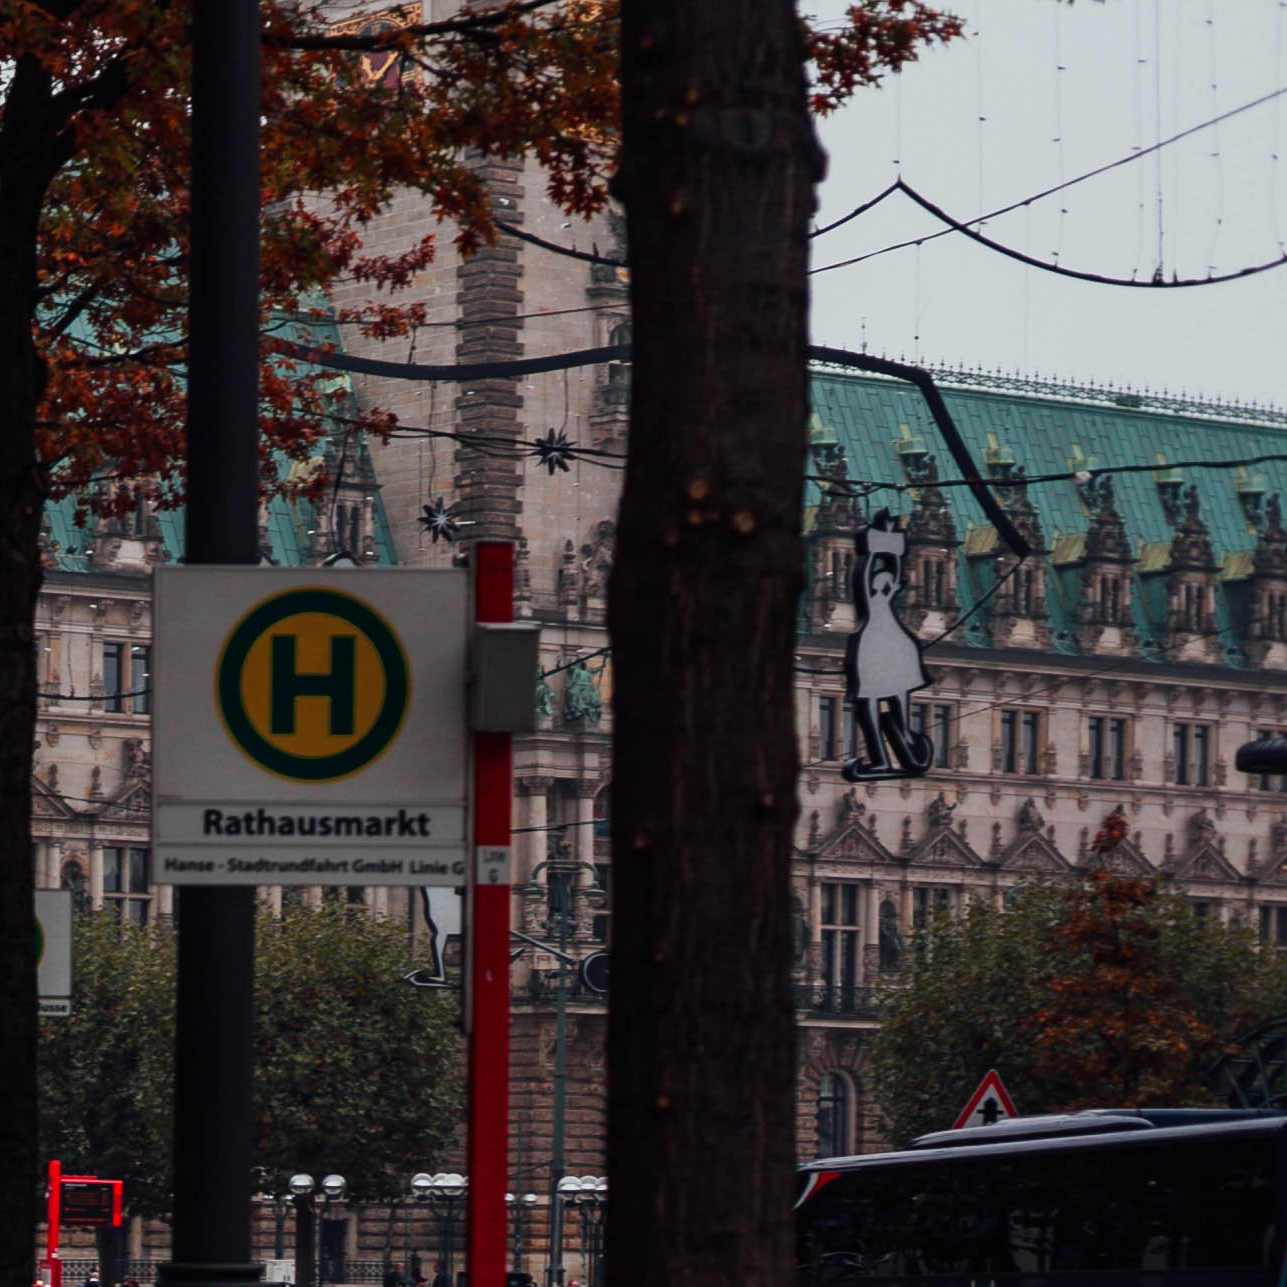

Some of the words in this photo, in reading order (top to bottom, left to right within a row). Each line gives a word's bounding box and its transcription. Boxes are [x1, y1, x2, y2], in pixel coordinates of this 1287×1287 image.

[272, 636, 355, 736] H
[203, 807, 430, 837] Rathausmarkt
[165, 858, 214, 873] Hanse
[228, 857, 348, 873] Stadtrundfahrt
[352, 859, 403, 874] GmbH
[409, 860, 448, 875] Linie
[38, 1002, 67, 1012] usse
